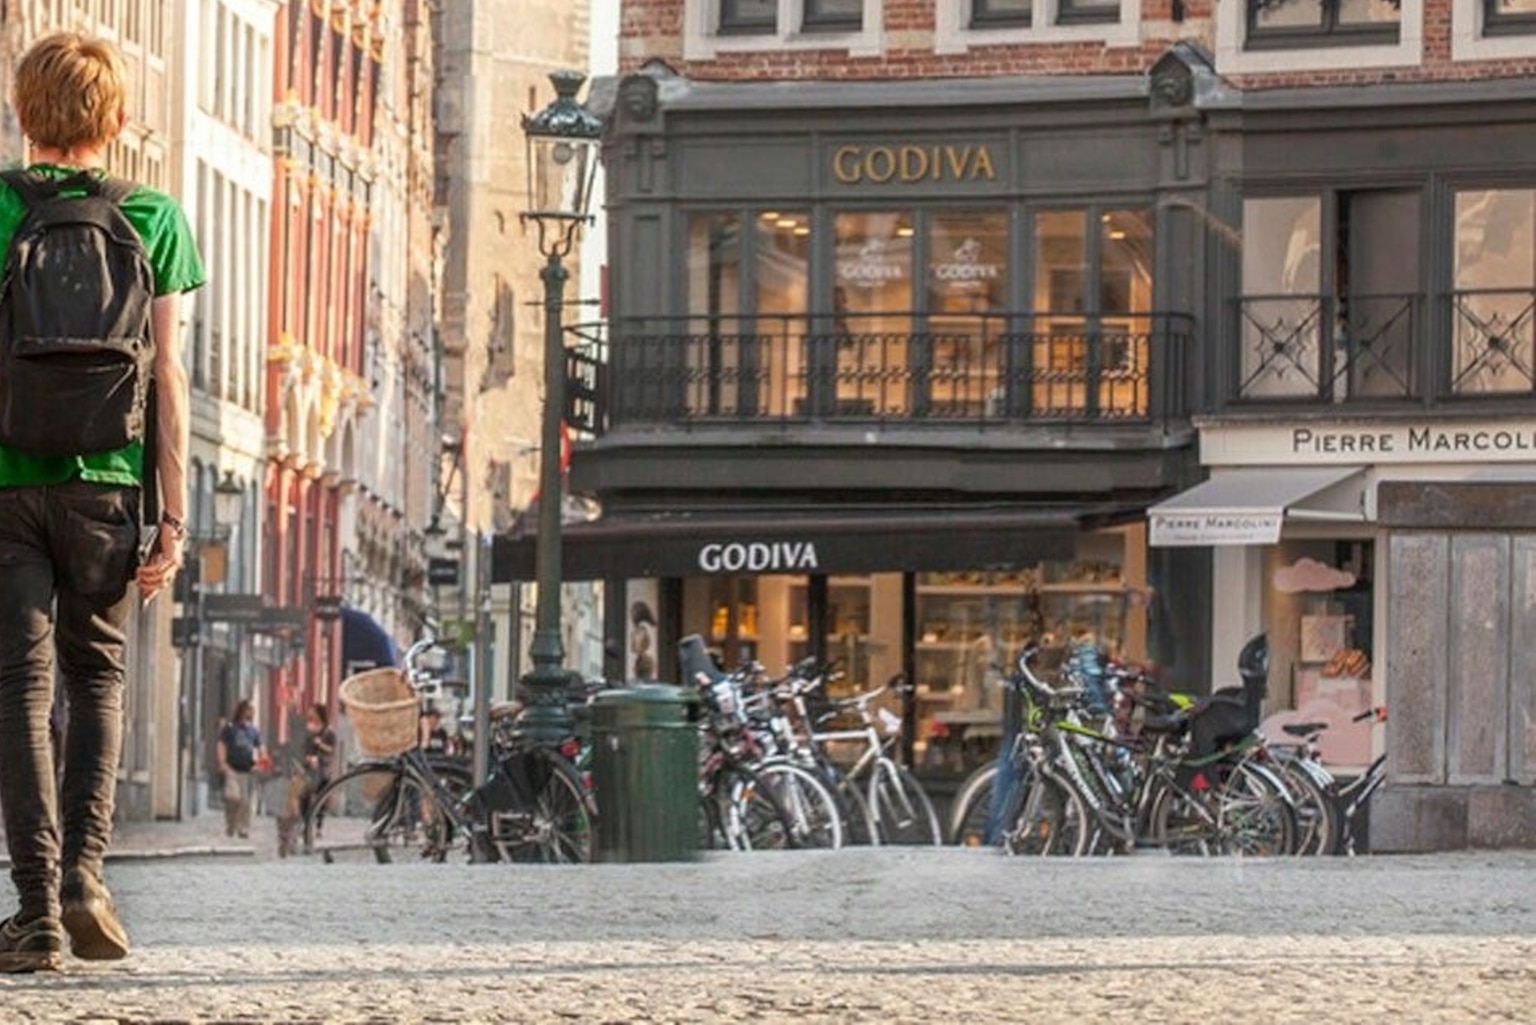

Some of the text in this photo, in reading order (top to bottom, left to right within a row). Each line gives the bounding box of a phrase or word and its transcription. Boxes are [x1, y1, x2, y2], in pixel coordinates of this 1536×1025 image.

[833, 145, 996, 183] GODIVA
[1292, 427, 1394, 453] PIERRE
[698, 541, 819, 572] GODIVA
